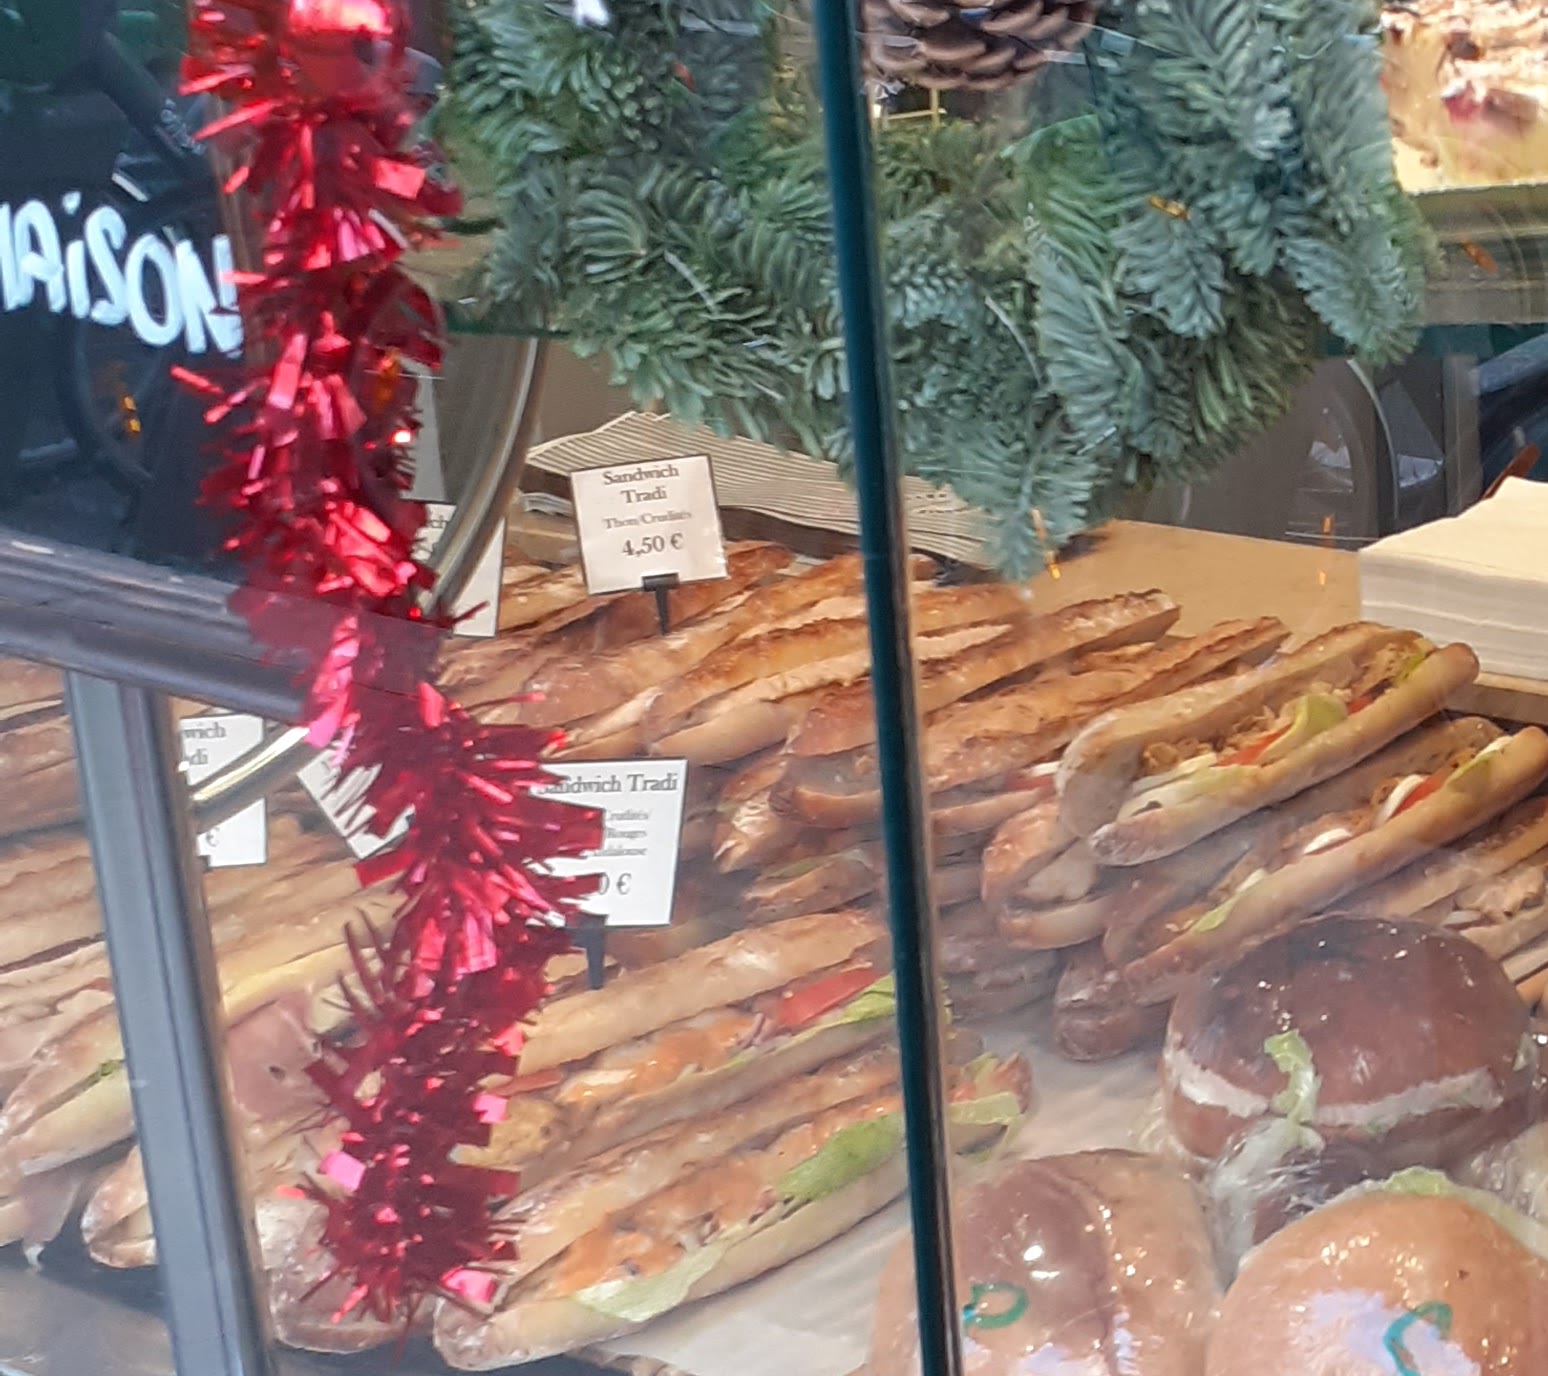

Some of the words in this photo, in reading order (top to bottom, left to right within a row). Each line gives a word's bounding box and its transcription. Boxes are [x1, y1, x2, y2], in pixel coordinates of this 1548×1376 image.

[602, 464, 680, 486] Sandwich
[620, 485, 667, 504] Tradi
[622, 535, 665, 558] 4,50
[670, 533, 684, 550] €
[627, 772, 679, 792] Tradi
